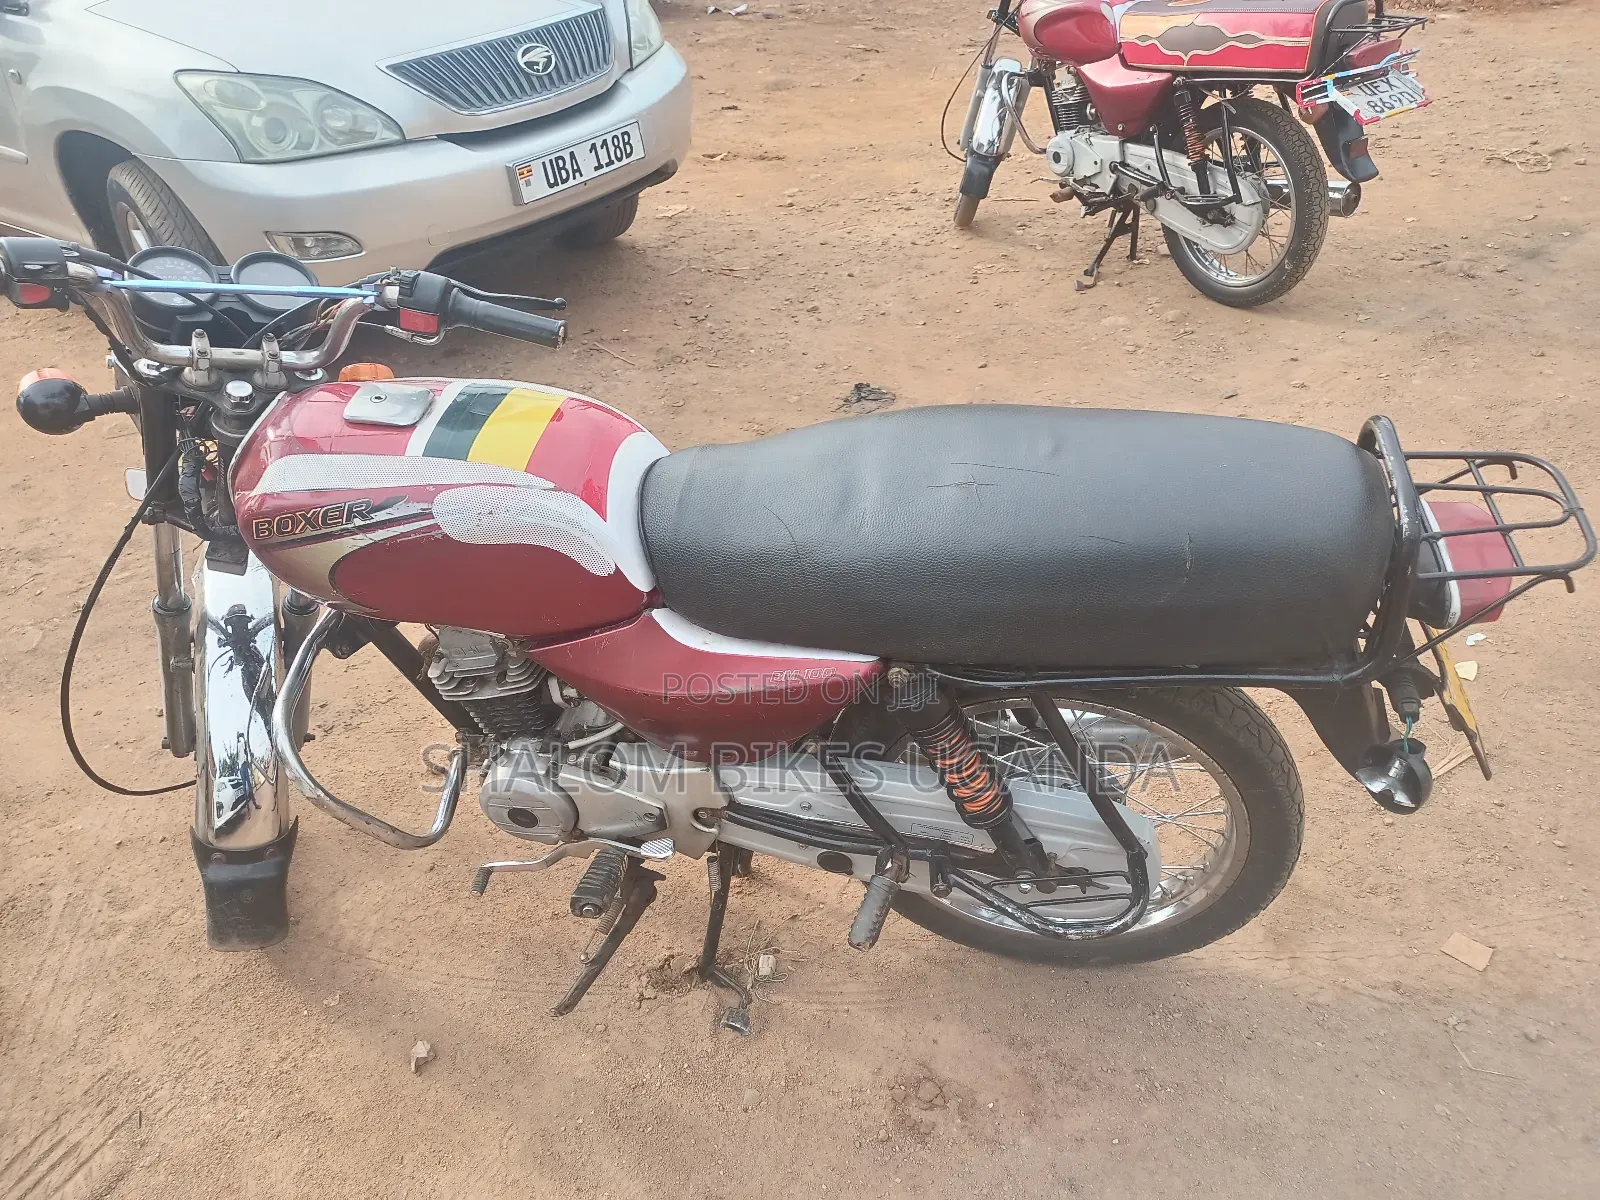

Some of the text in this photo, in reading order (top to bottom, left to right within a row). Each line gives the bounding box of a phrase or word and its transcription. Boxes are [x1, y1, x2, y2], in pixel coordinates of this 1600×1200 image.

[1358, 77, 1400, 97] UEX
[541, 130, 634, 189] UBA 118B
[252, 498, 376, 540] BOXER
